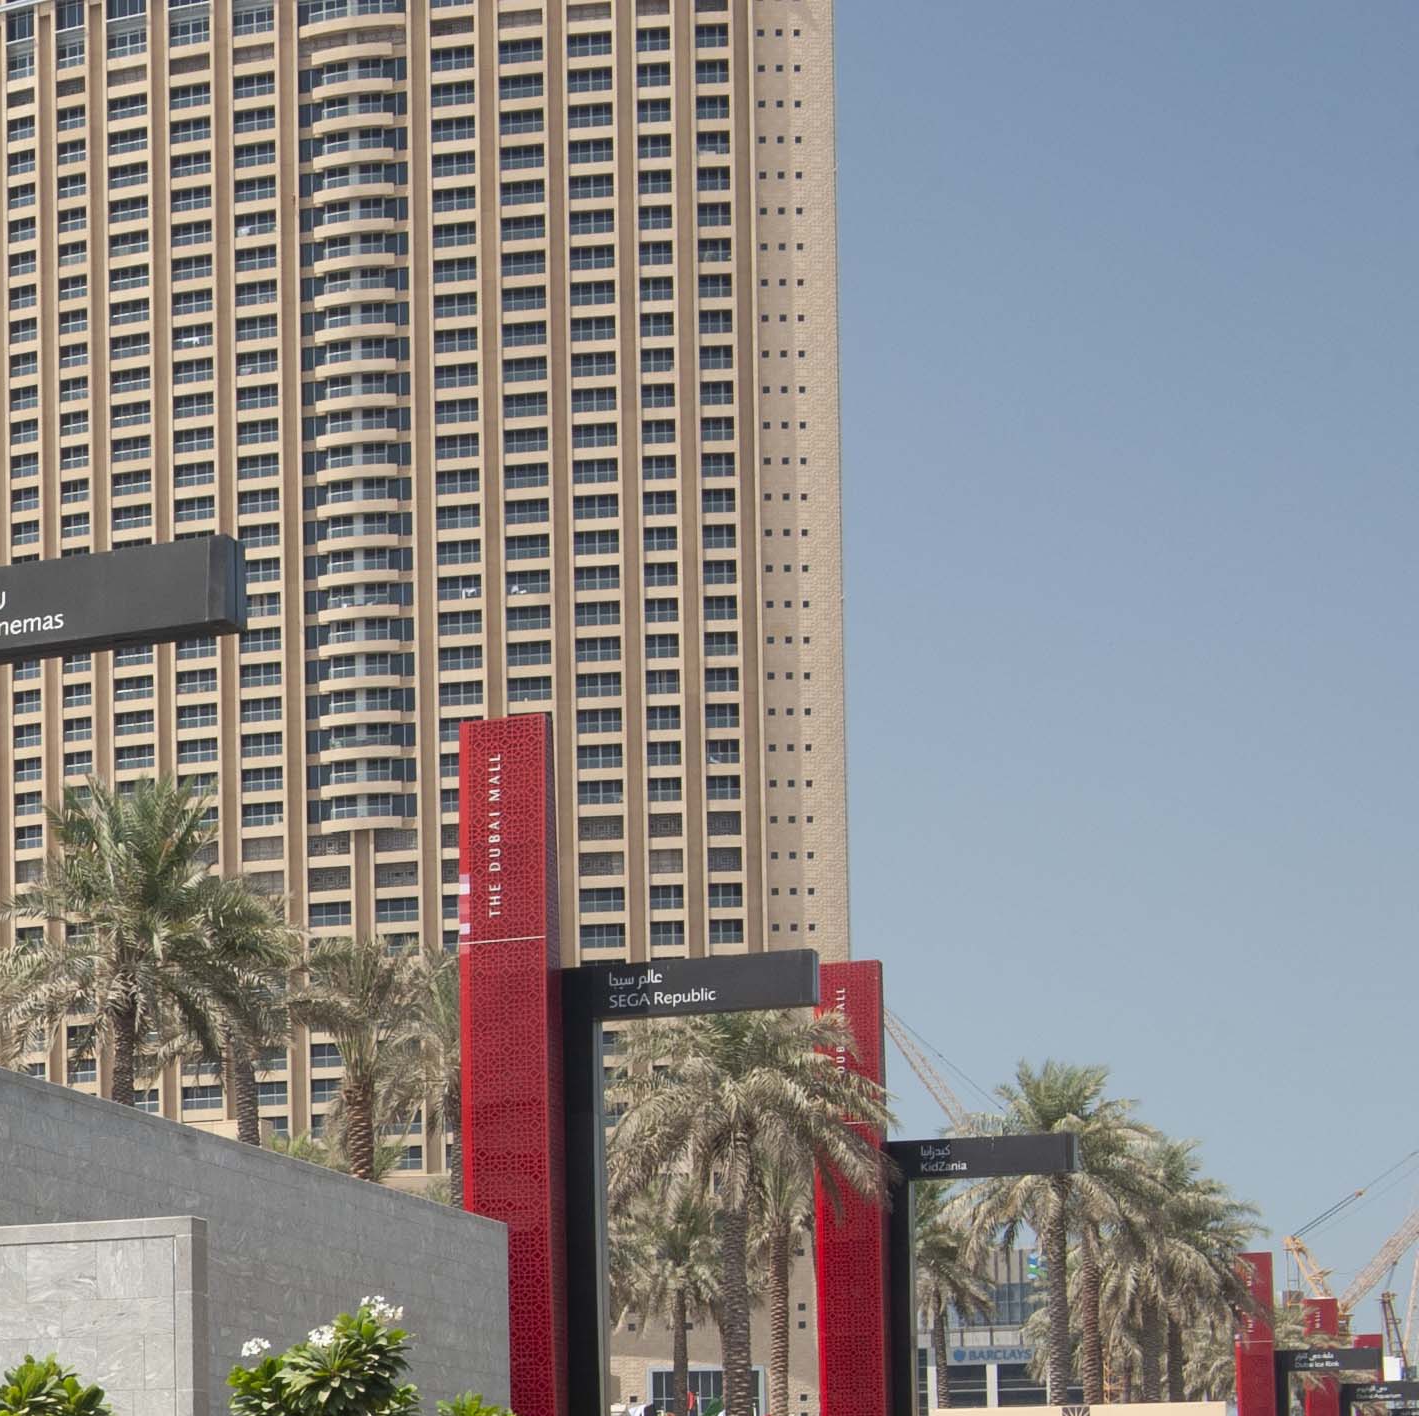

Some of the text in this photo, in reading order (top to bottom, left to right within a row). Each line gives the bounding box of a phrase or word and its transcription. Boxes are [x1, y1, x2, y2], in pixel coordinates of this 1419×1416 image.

[488, 753, 501, 918] THE DUBAI MALL
[609, 987, 716, 1009] SEGA Republic
[920, 1161, 968, 1173] KidZania
[969, 1349, 1032, 1361] BARCLAYS
